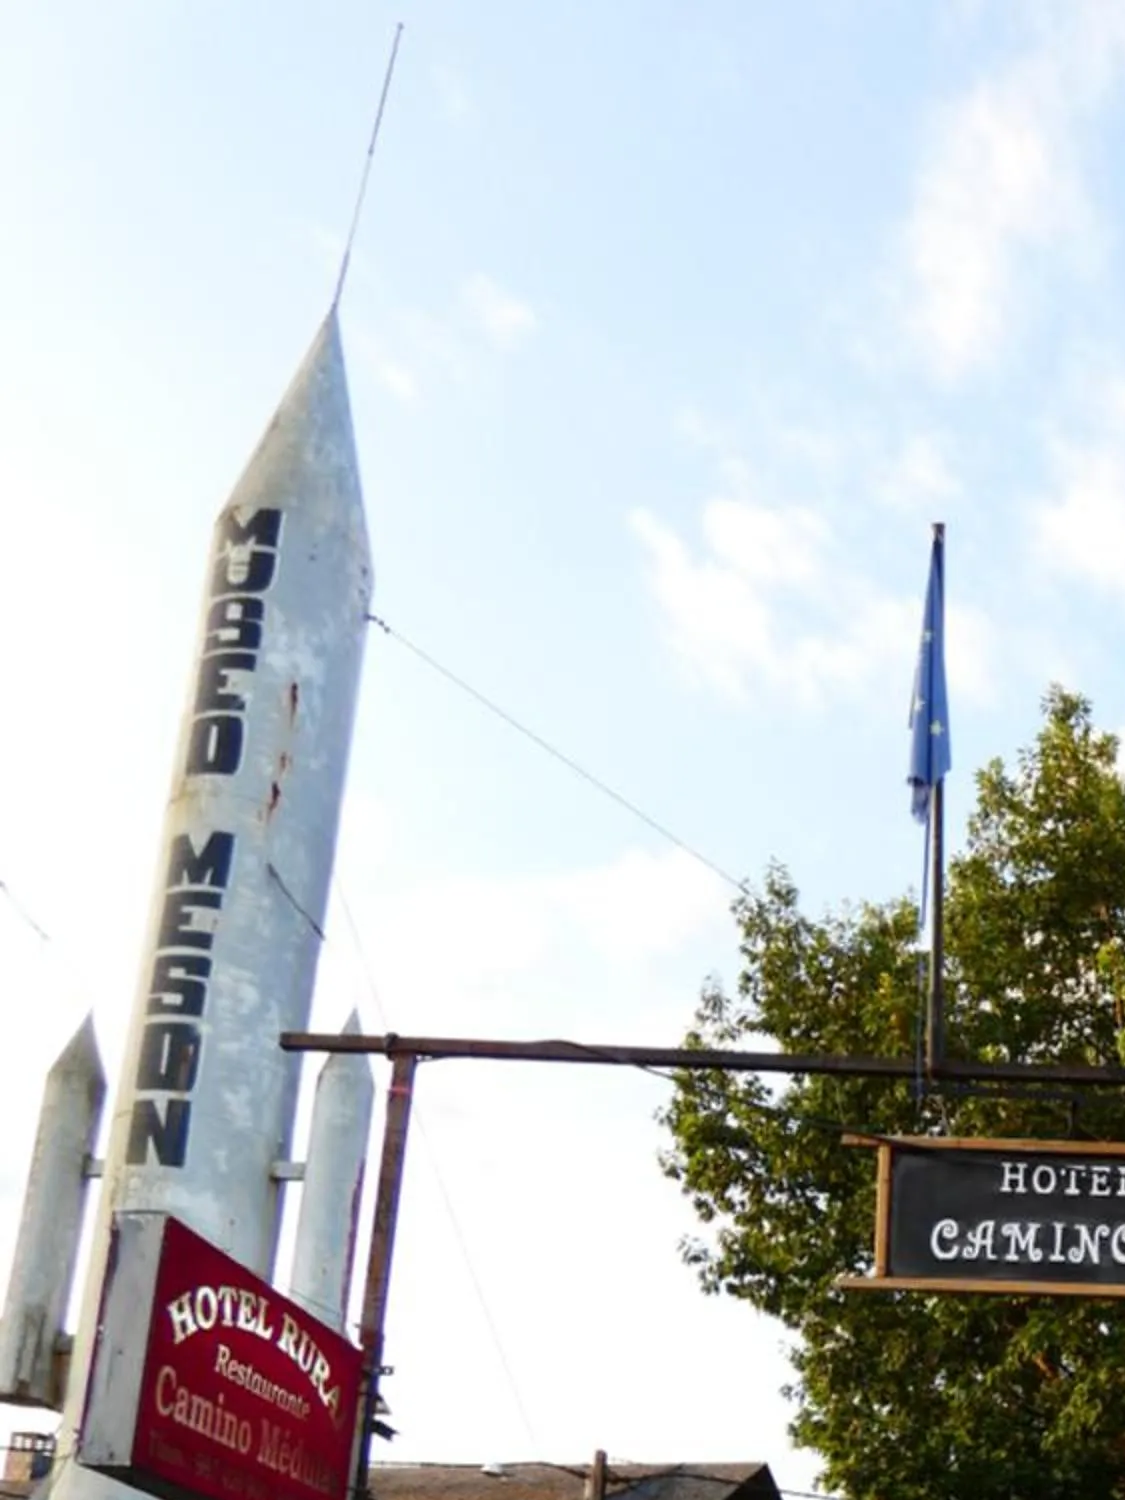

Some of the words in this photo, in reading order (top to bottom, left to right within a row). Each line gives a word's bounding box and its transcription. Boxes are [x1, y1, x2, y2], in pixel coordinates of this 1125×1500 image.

[184, 507, 284, 776] MUSEO
[125, 831, 235, 1168] MESON
[167, 1285, 274, 1344] HOTEL
[277, 1312, 346, 1430] RURA
[214, 1344, 311, 1420] Restaurante
[155, 1365, 252, 1454] Camino
[256, 1417, 340, 1497] Médula
